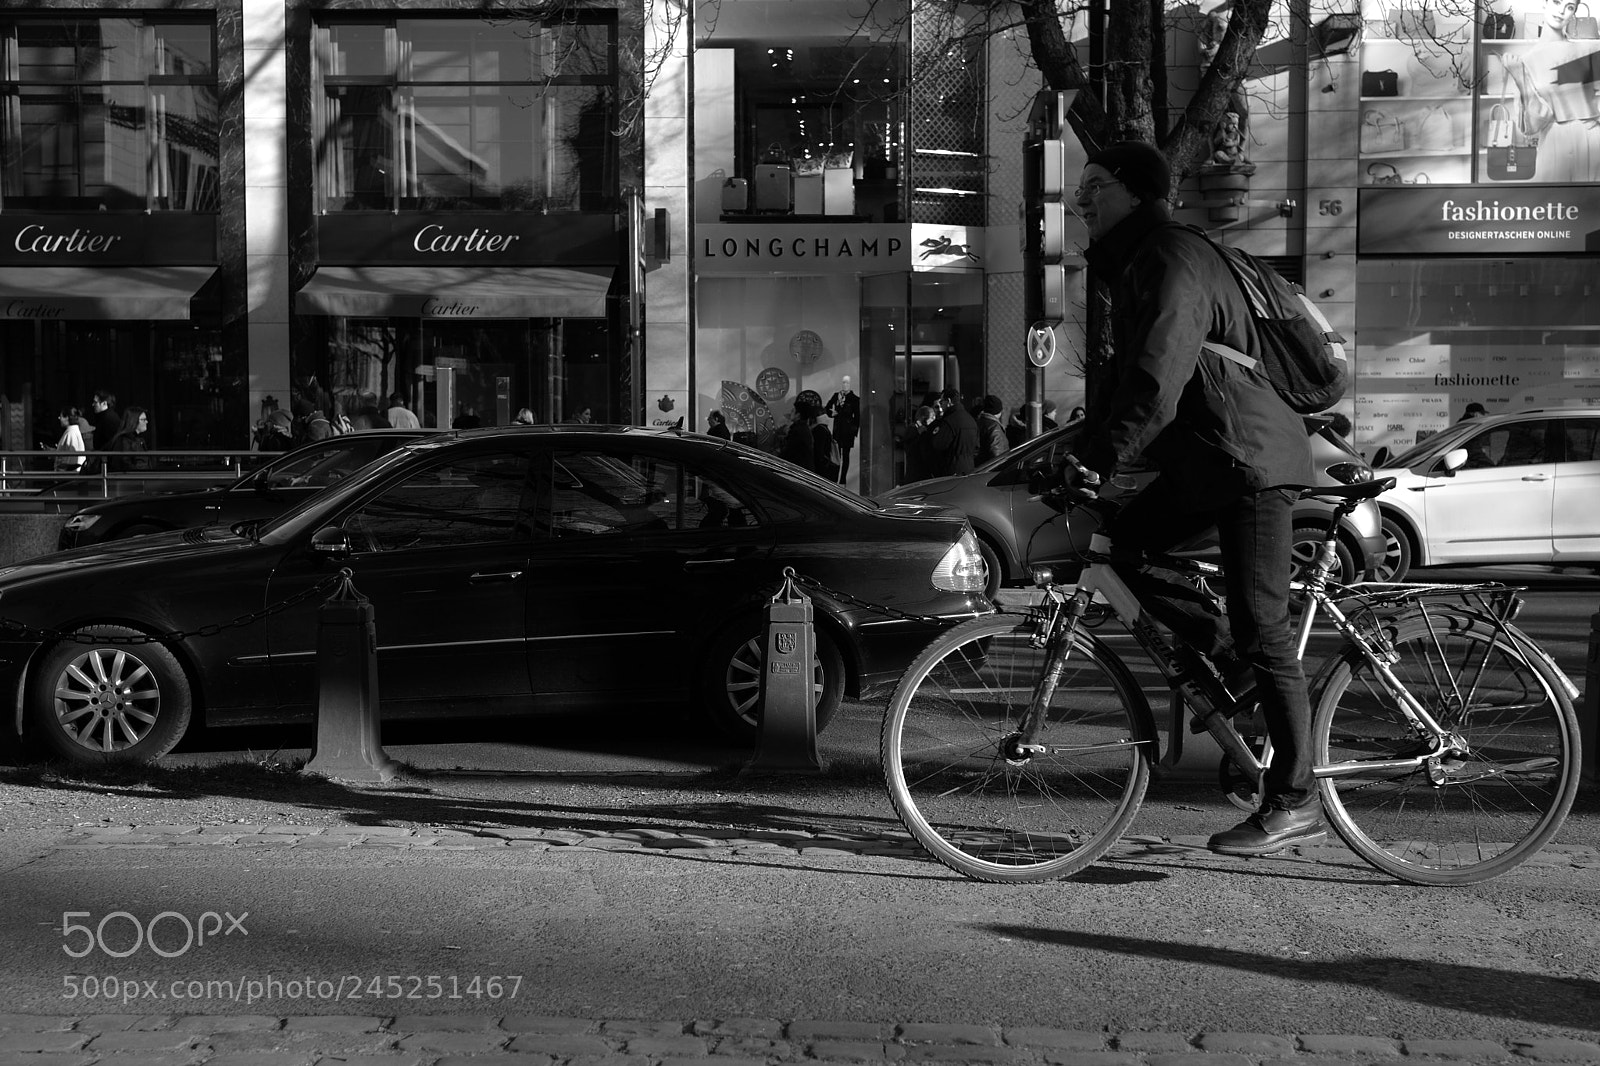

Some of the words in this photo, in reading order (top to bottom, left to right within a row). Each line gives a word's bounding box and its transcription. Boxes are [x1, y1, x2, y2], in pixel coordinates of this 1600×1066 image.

[1319, 200, 1342, 216] 56
[1441, 200, 1579, 221] fashionette
[14, 224, 121, 254] Cartier
[413, 224, 520, 254] Cartier
[1448, 230, 1535, 240] DESIGNERTASCHEN
[1537, 230, 1571, 239] ONLINE
[705, 237, 903, 258] LONGCHAMP
[6, 299, 66, 318] Cartier
[421, 297, 480, 315] Cartier
[1434, 373, 1520, 386] fashionette
